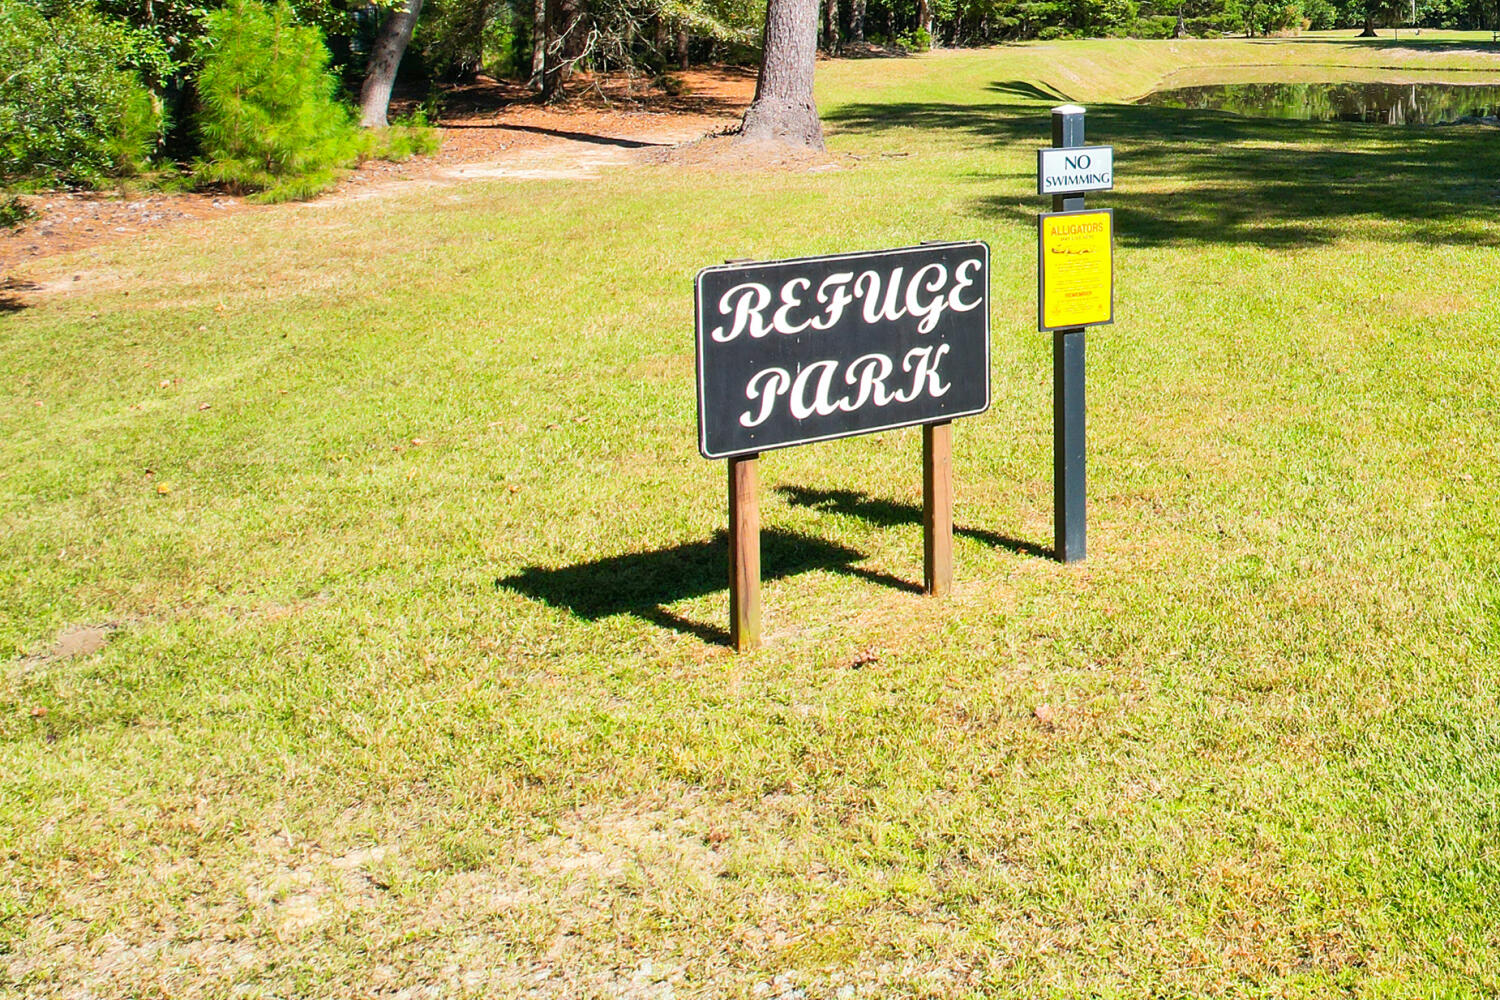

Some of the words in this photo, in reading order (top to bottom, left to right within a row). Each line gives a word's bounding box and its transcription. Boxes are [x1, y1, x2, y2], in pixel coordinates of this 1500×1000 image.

[1064, 154, 1091, 170] NO
[1045, 172, 1110, 188] SWIMMING
[1050, 222, 1104, 236] ALLIGATORS
[711, 258, 983, 343] REFUGE
[738, 342, 952, 428] PARK
